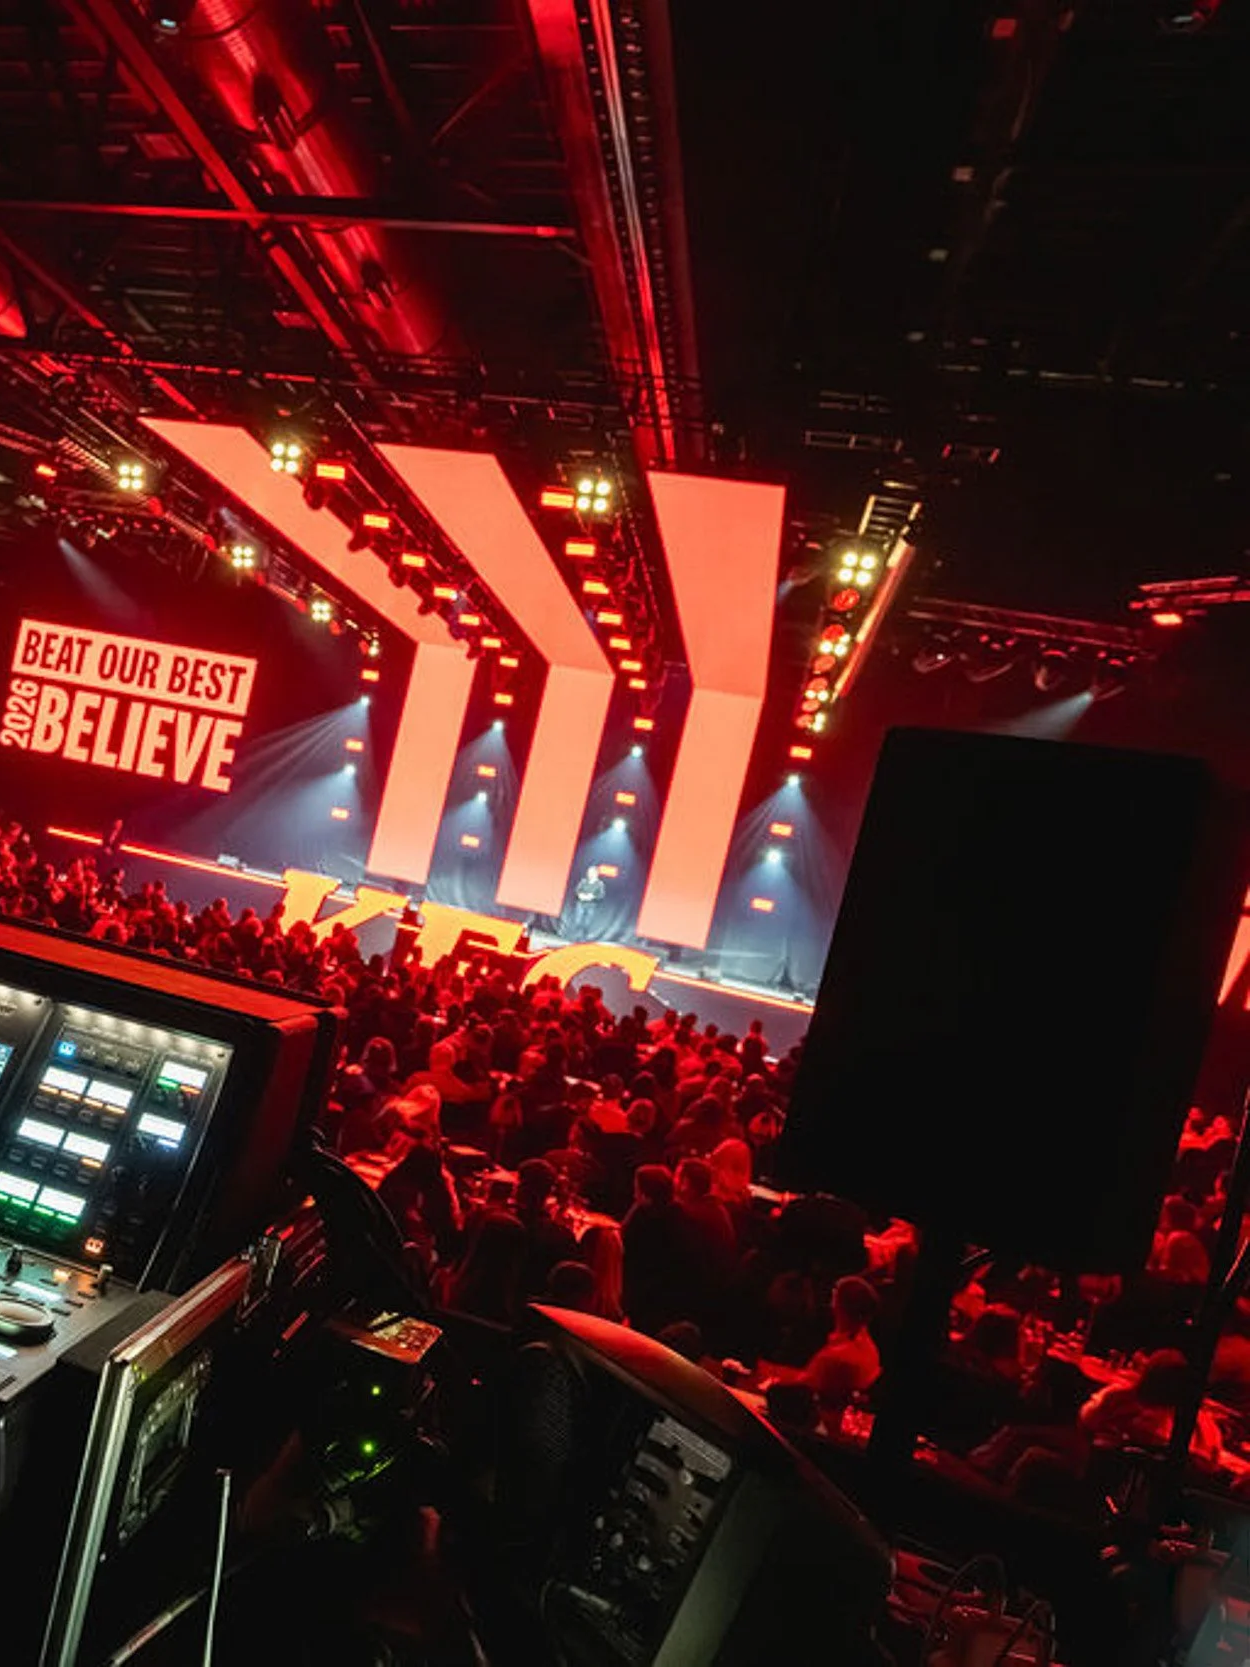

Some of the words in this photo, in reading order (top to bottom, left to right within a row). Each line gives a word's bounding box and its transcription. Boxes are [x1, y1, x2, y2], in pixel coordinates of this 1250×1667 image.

[22, 629, 92, 675] BEAT
[99, 643, 160, 690] OUR
[167, 656, 247, 704] BEST
[0, 679, 39, 749] 2026
[30, 684, 243, 793] BELIEVE
